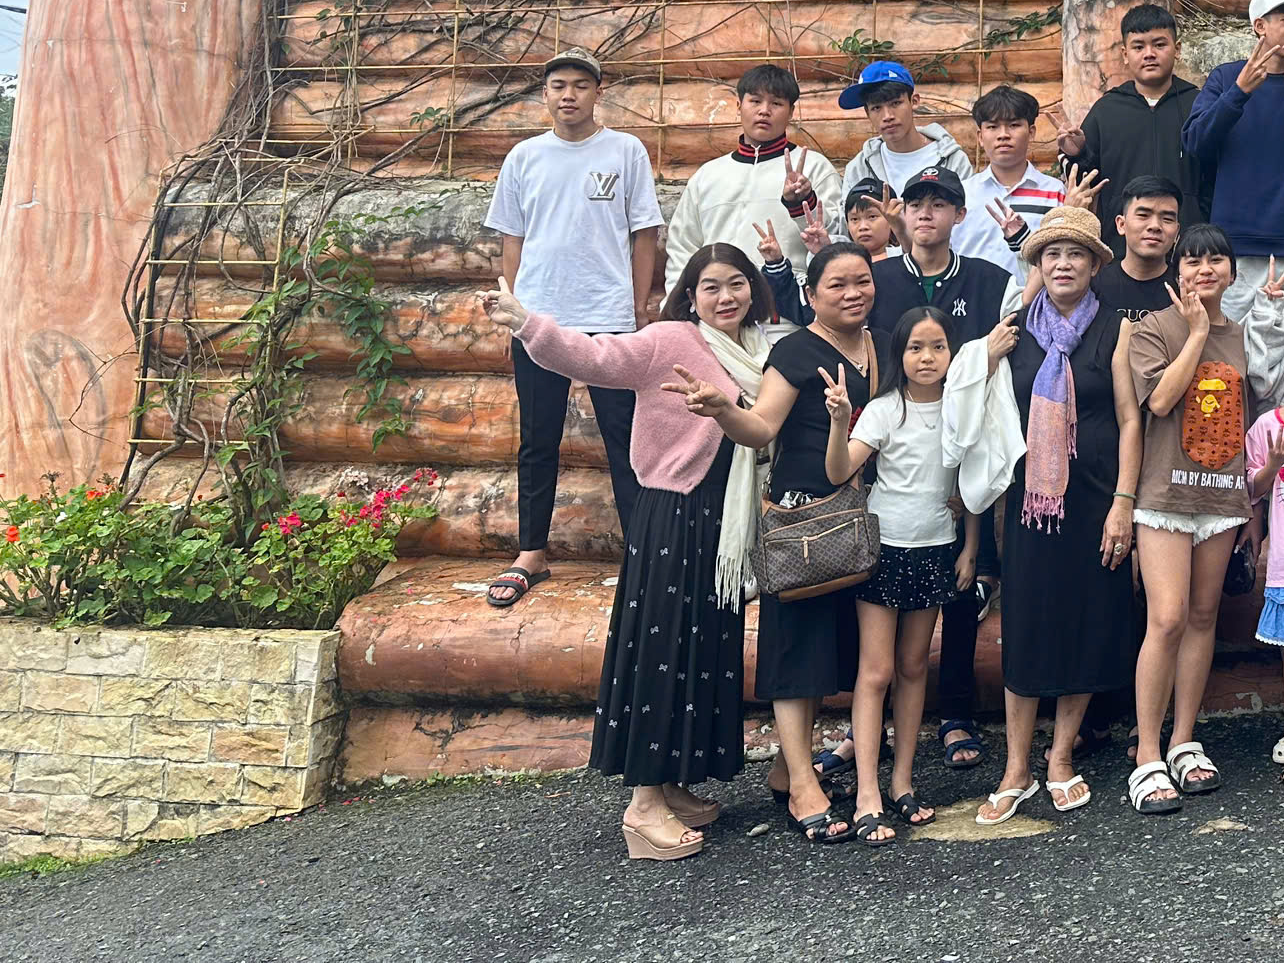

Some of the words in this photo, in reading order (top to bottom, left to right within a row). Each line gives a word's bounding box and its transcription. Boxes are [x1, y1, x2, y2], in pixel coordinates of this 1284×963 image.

[1171, 469, 1187, 485] MCM
[1189, 471, 1199, 486] BY
[1201, 473, 1233, 488] BATHING
